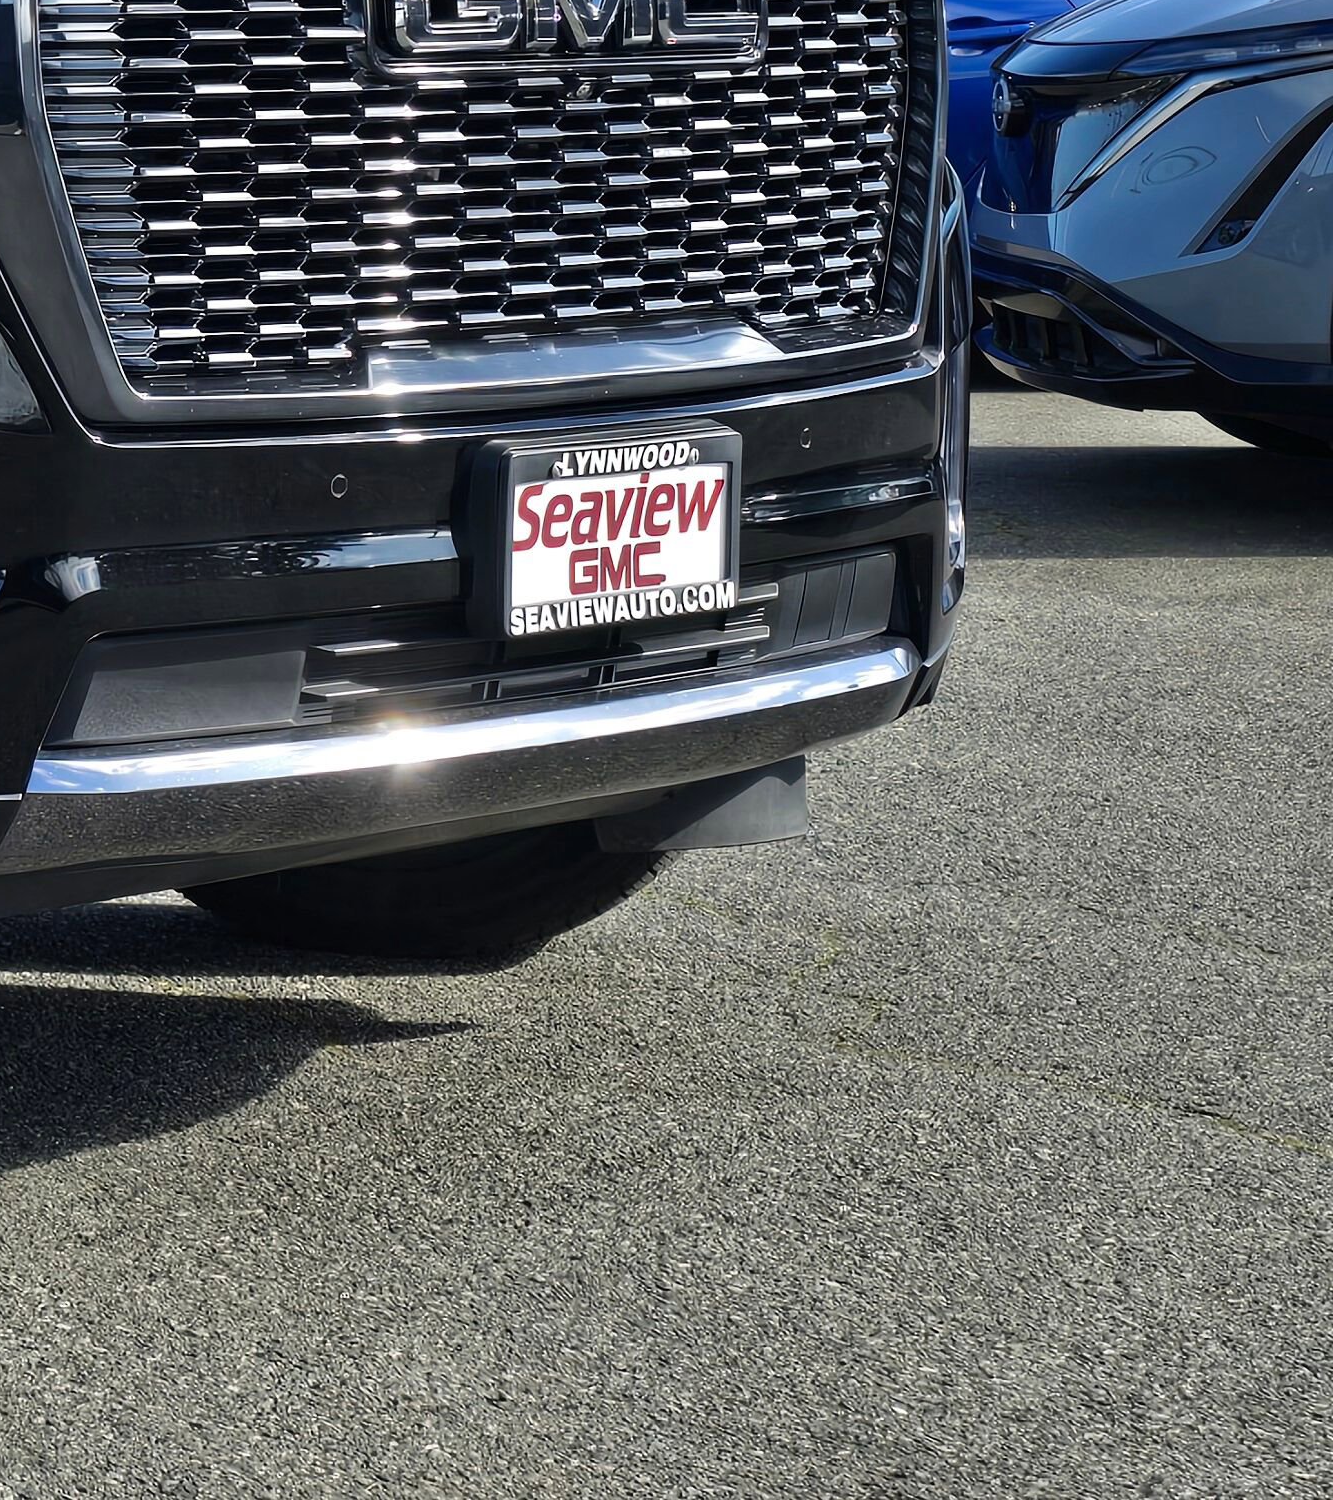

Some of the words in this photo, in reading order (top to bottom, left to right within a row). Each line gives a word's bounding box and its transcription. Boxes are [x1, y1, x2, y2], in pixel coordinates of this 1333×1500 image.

[560, 441, 691, 477] LYNNWOOD
[512, 472, 725, 552] Seaview
[568, 541, 667, 596] GMC
[510, 581, 735, 636] SEAVIEWAUTO.COM
